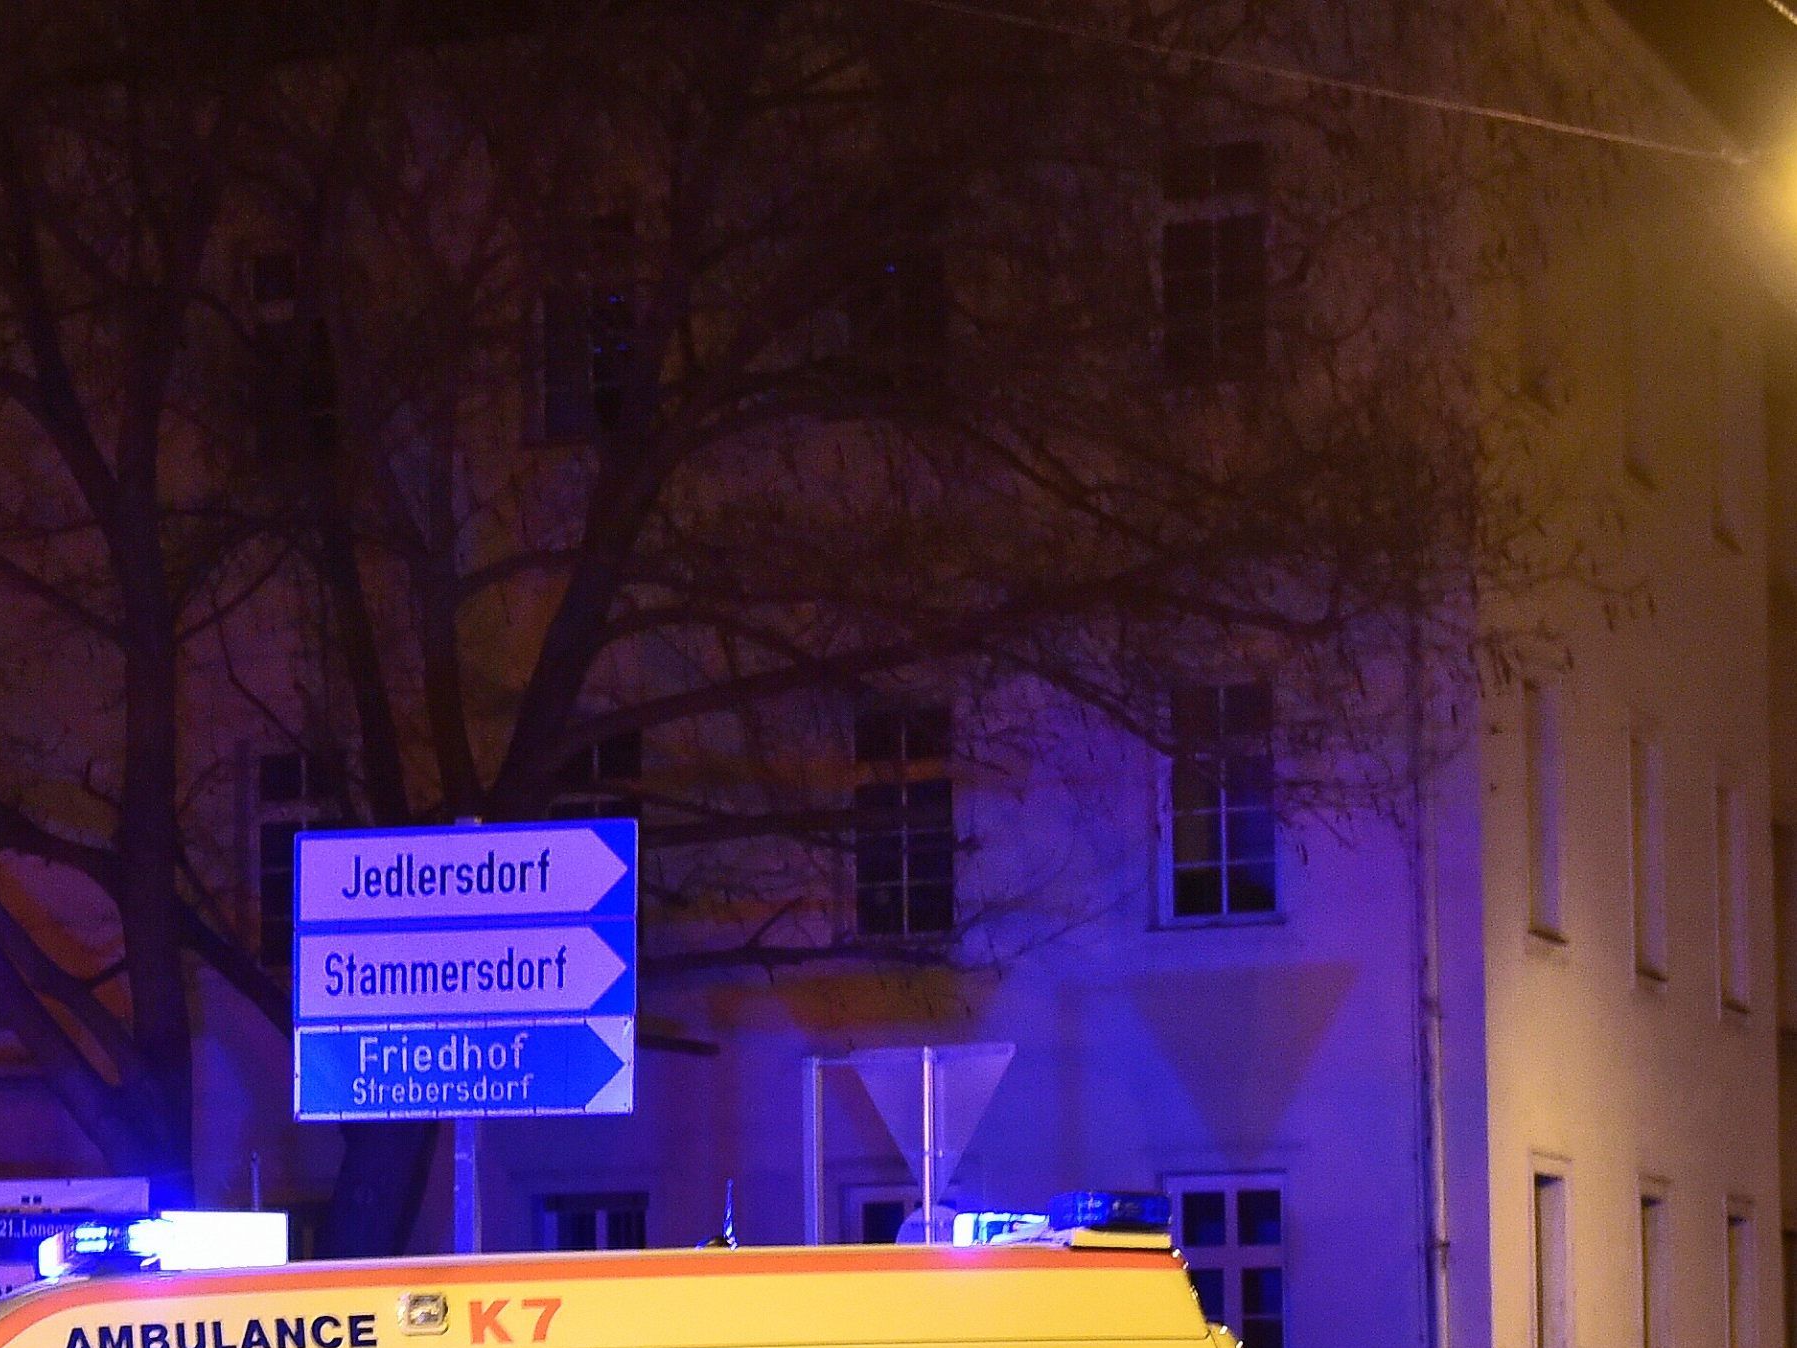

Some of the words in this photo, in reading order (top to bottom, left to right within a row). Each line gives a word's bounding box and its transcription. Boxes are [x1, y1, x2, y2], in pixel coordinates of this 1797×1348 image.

[342, 848, 550, 900] Jedlersdorf
[324, 944, 567, 997] Stammersdorf
[358, 1032, 529, 1075] Friedhof
[352, 1073, 534, 1106] Strebersdorf
